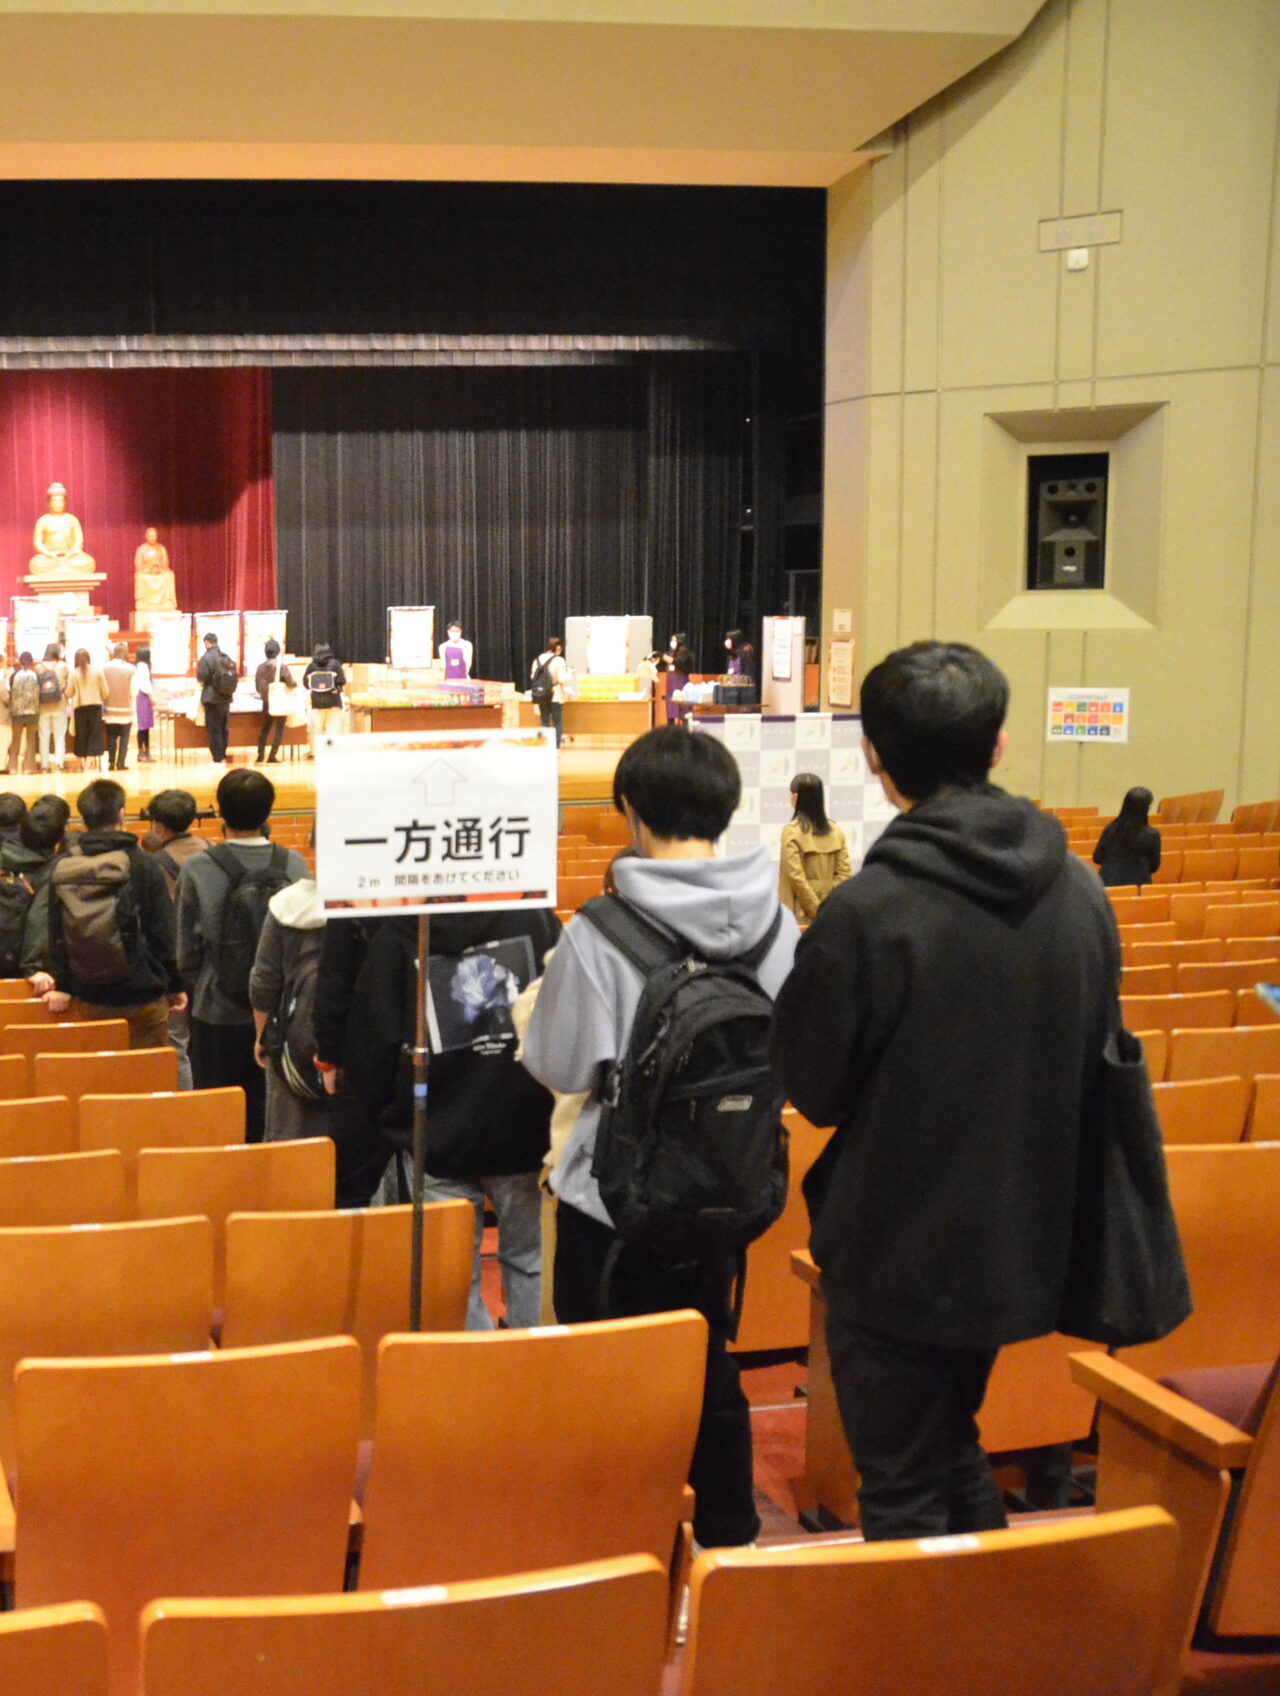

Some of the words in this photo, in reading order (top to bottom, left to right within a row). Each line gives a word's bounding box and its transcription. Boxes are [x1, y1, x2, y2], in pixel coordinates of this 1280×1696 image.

[344, 815, 532, 864] 一方通行
[394, 870, 520, 886] 間隔をあけてください
